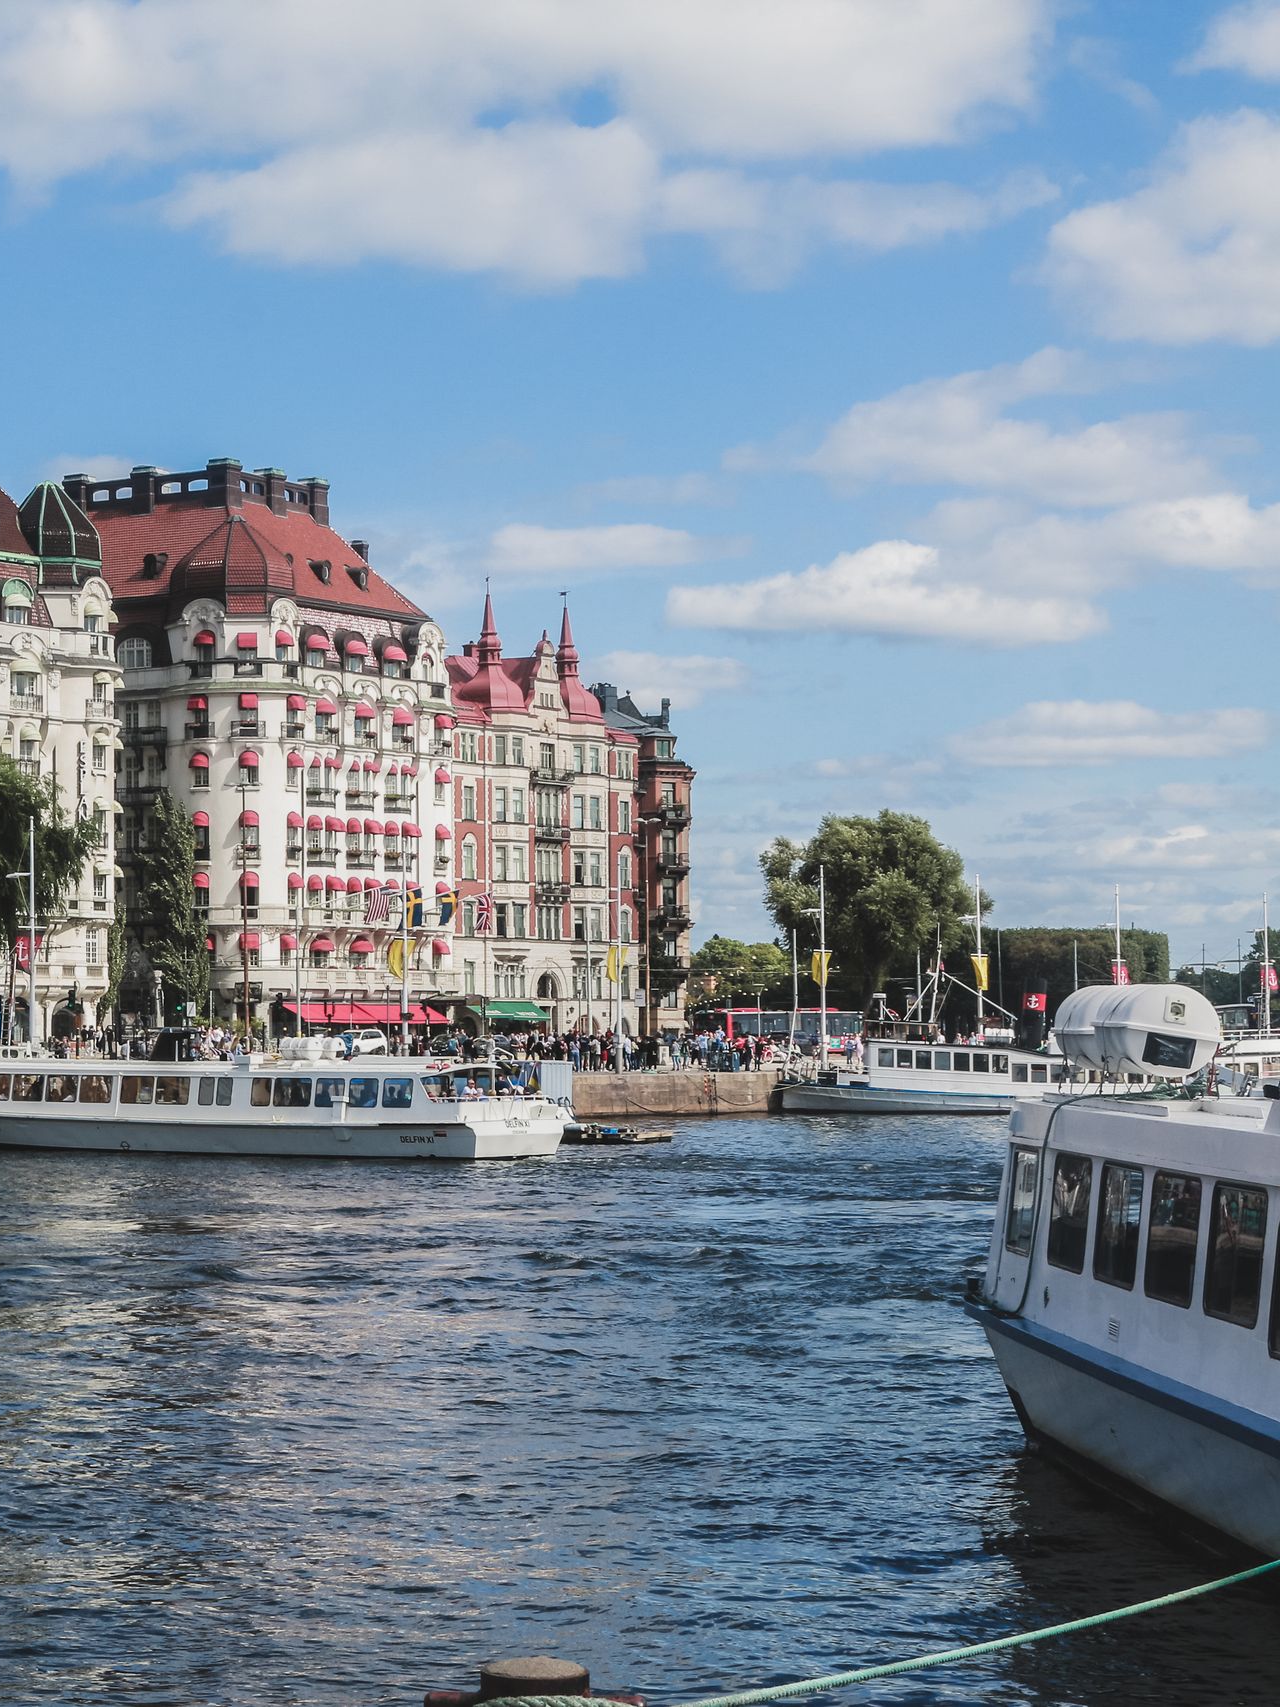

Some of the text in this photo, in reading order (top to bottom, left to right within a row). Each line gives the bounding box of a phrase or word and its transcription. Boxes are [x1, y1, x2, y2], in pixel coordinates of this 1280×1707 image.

[77, 739, 88, 824] ESPLAN
[504, 1120, 524, 1128] DELFIN
[400, 1135, 434, 1144] DELFIN XI
